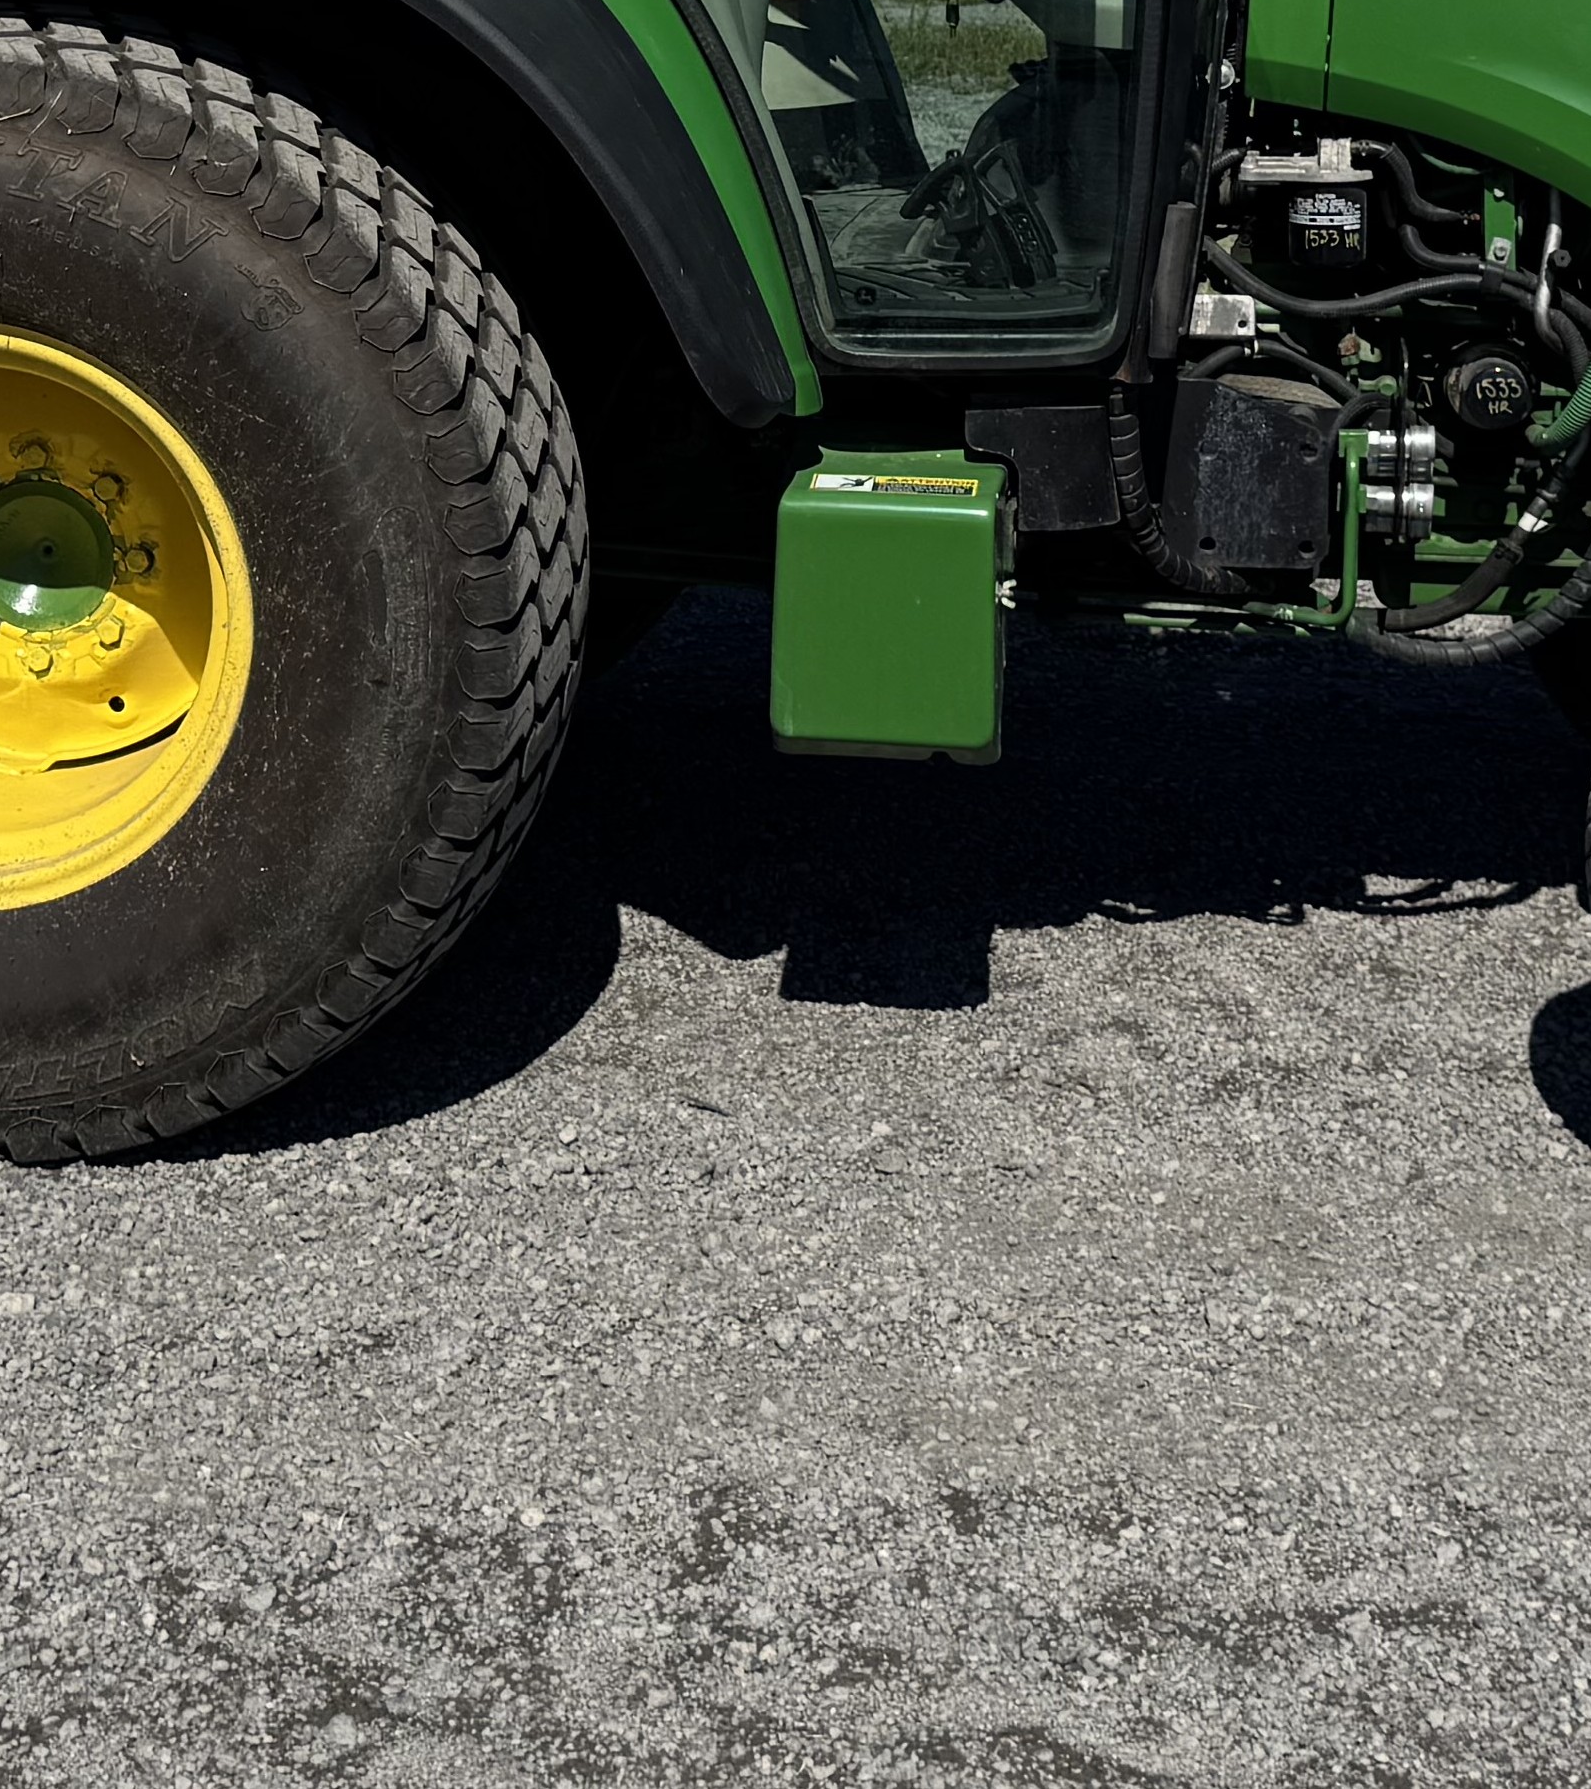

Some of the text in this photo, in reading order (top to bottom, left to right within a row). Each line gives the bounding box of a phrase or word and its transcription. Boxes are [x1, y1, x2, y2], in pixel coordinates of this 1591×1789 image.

[1305, 229, 1340, 250] 1533
[1476, 377, 1522, 400] 1533
[1488, 400, 1513, 414] HR
